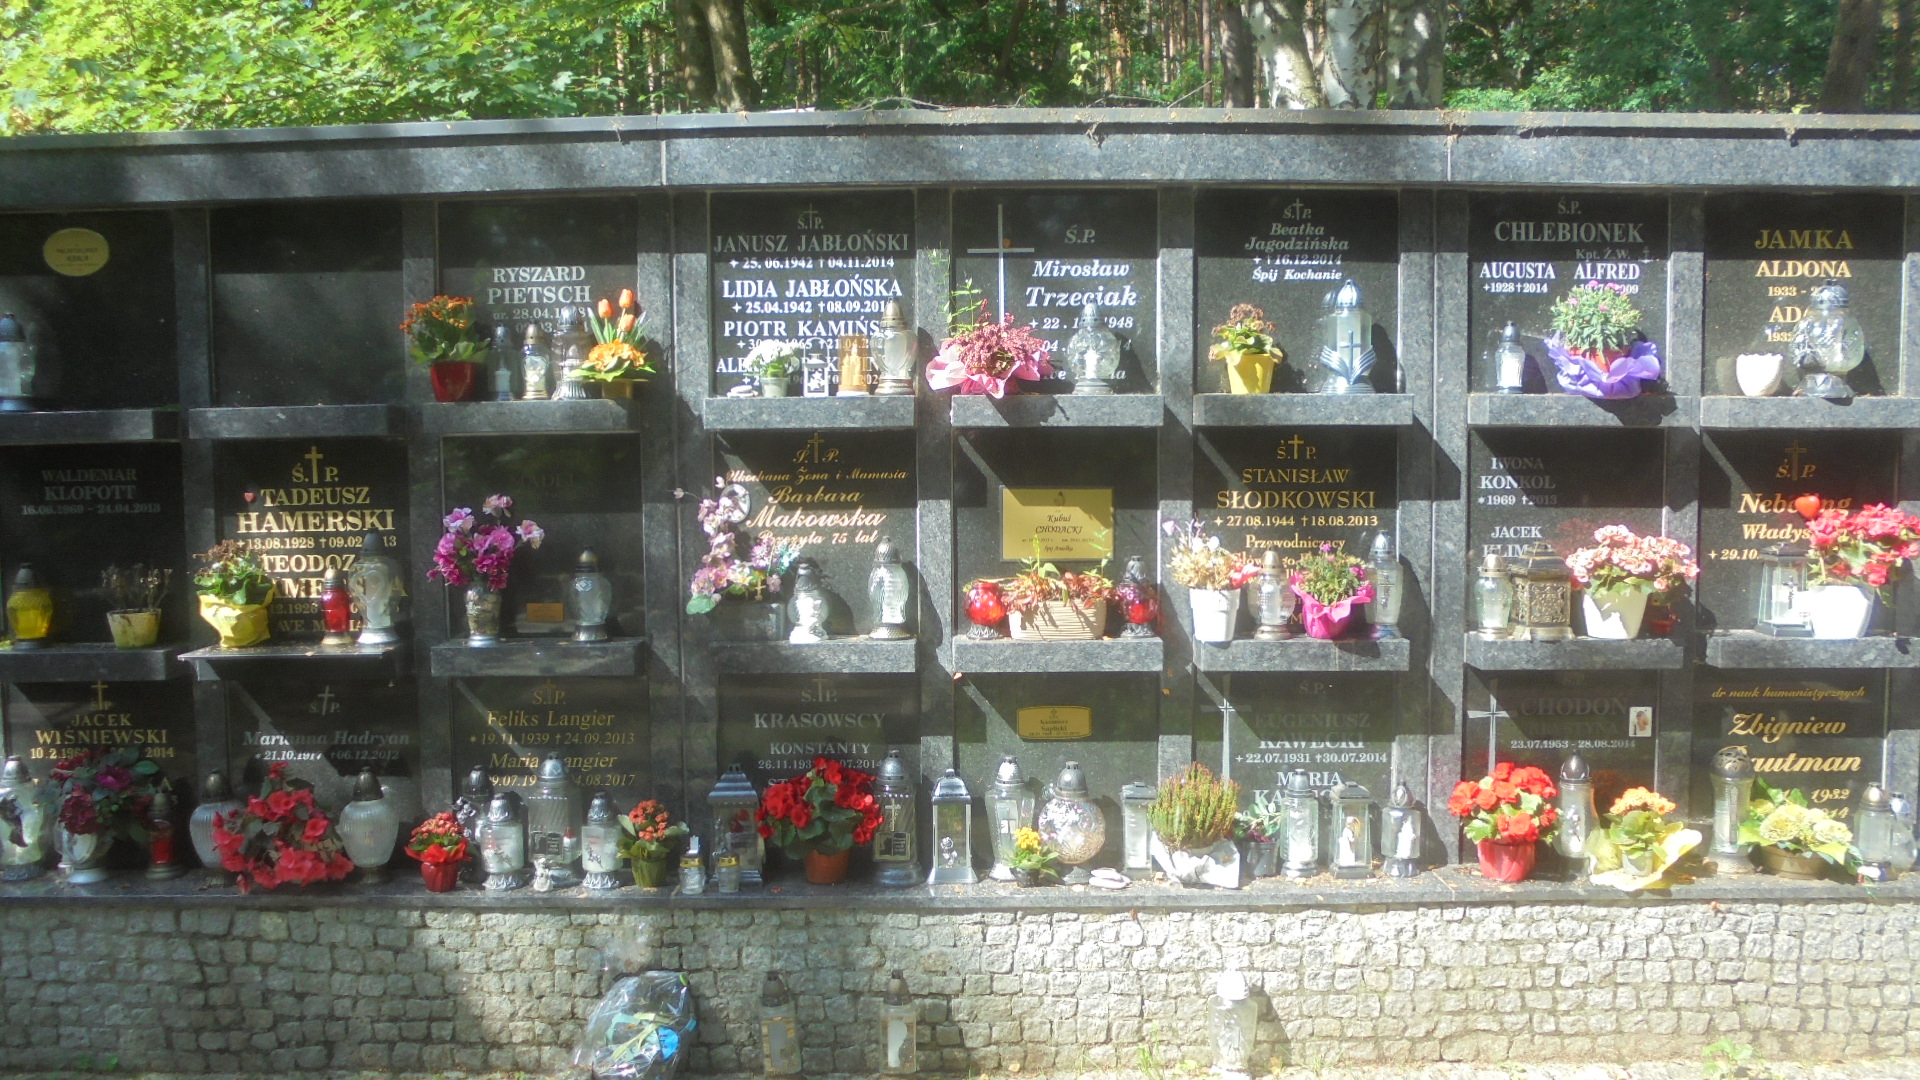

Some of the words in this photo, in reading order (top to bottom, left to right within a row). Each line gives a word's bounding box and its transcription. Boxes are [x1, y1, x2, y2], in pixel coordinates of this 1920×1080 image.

[1269, 222, 1325, 236] Beatka
[1494, 221, 1644, 243] CHLEBIONEK
[714, 234, 789, 253] JANUSZ
[797, 229, 909, 252] JABŁOŃSKI
[1244, 236, 1349, 253] Jagodzińska
[1755, 229, 1854, 249] JAMKA
[828, 256, 895, 268] 04.11.2014
[1274, 254, 1342, 265] 16.12.2014
[493, 266, 586, 283] RYSZARD
[1032, 259, 1129, 277] Mirosław
[1252, 266, 1279, 282] Śpij
[1284, 269, 1342, 280] Kochanie
[1479, 262, 1556, 279] AUGUSTA
[1573, 263, 1640, 280] ALFRED
[1755, 260, 1852, 278] ALDONA
[722, 280, 778, 298] LIDIA
[785, 273, 903, 298] JABŁOŃSKA
[487, 285, 591, 305] PIETSCH
[1025, 285, 1137, 307] Trzeciak
[745, 301, 813, 314] 25.04.1942
[827, 300, 886, 314] 08.09.201
[723, 321, 788, 337] PIOTR
[1491, 457, 1544, 470] IWONA
[42, 469, 137, 482] WALDEMAR
[846, 468, 909, 480] Mamusia
[1242, 469, 1349, 483] STANISŁAW
[1480, 475, 1556, 489] KONKOL
[260, 487, 371, 507] TADEUSZ
[768, 485, 865, 504] Barbara
[1216, 490, 1376, 509] SŁODKOWSKI
[236, 509, 396, 533] HAMERSKI
[746, 505, 886, 528] Makowska
[1226, 515, 1295, 527] 27.08.1944
[1311, 515, 1378, 527] 18.08.2013
[832, 532, 847, 545] 75
[854, 530, 878, 544] lat
[1491, 526, 1543, 539] JACEK
[278, 620, 304, 632] AVE
[1712, 687, 1726, 698] dr
[1729, 686, 1760, 698] nauk
[1763, 686, 1867, 701] humanistycznych
[72, 714, 132, 727] JACEK
[487, 710, 539, 727] Feliks
[547, 709, 615, 730] Langier
[754, 713, 885, 729] KRASOWSCY
[1255, 713, 1371, 728] EUGENIUSZ
[36, 725, 168, 745] WIŚNIEWSKI
[1728, 713, 1846, 743] Zbigniew
[333, 730, 410, 747] Hadryan
[564, 732, 635, 745] 24.09.2013
[1259, 731, 1365, 749] KAWECKI
[770, 742, 872, 755] KONSTANTY
[489, 752, 539, 769] Maria
[564, 753, 617, 772] angier
[1246, 752, 1311, 764] 22.07.1931
[1323, 752, 1387, 763] 30.07.2014
